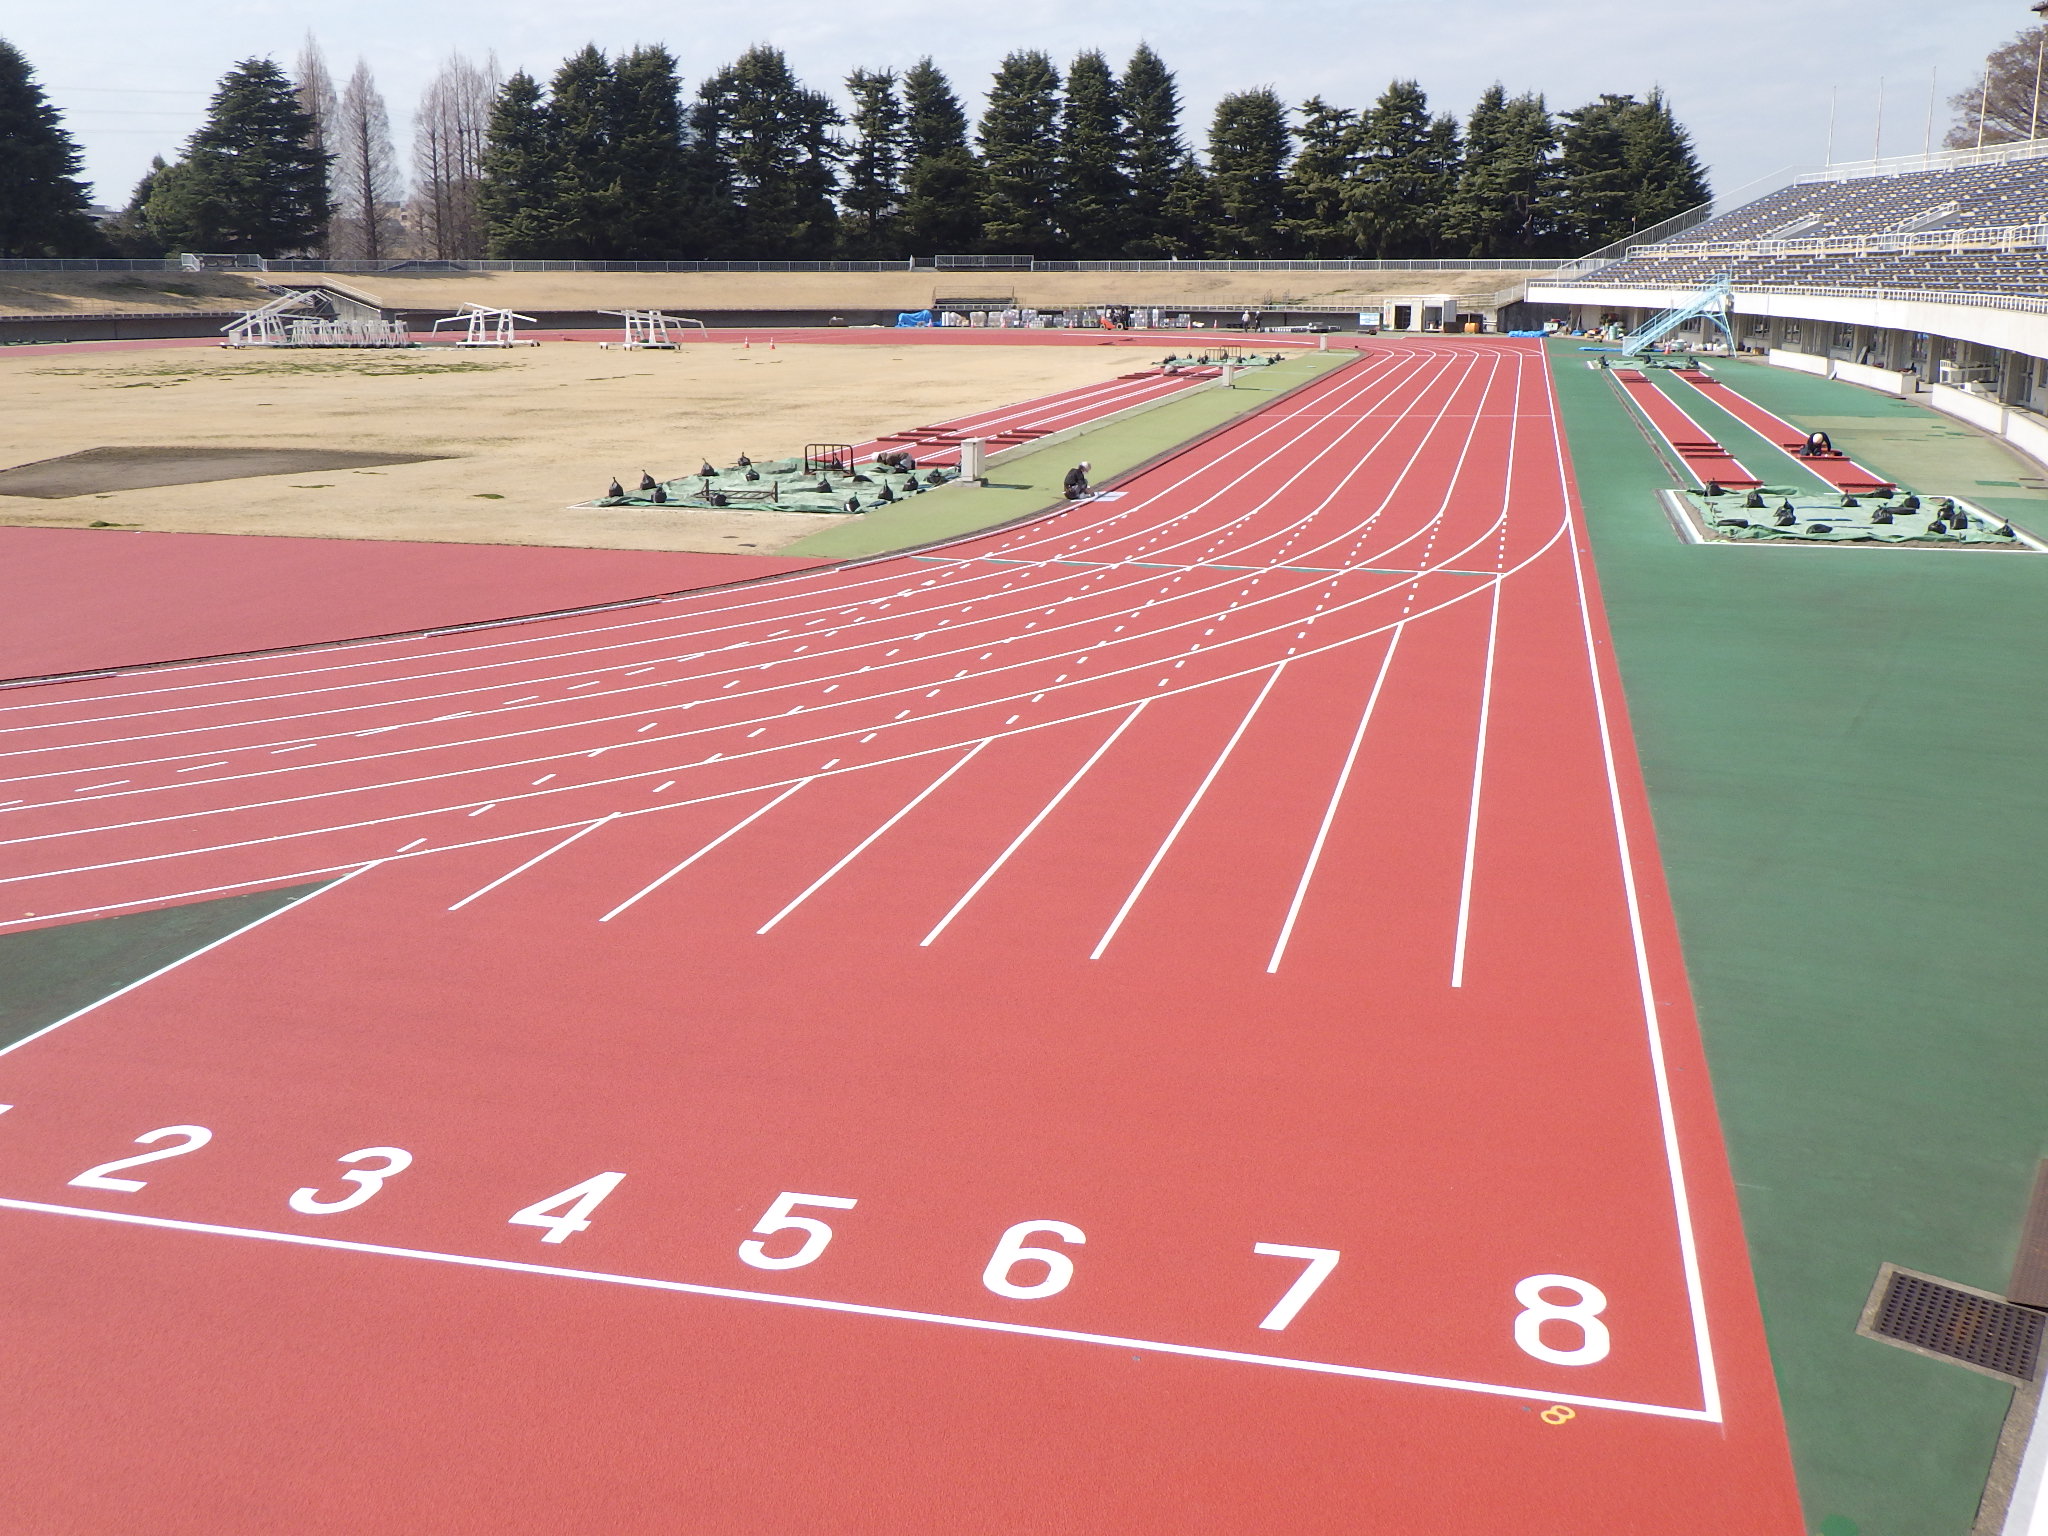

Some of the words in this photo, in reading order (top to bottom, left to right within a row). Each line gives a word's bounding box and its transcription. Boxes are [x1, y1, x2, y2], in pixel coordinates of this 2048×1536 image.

[68, 1125, 212, 1192] 2
[289, 1147, 412, 1214] 3
[508, 1172, 626, 1243] 4
[739, 1192, 857, 1270] 5
[983, 1220, 1086, 1299] 6
[1254, 1242, 1340, 1330] 7
[1515, 1274, 1610, 1366] 8
[1540, 1405, 1576, 1425] 8
